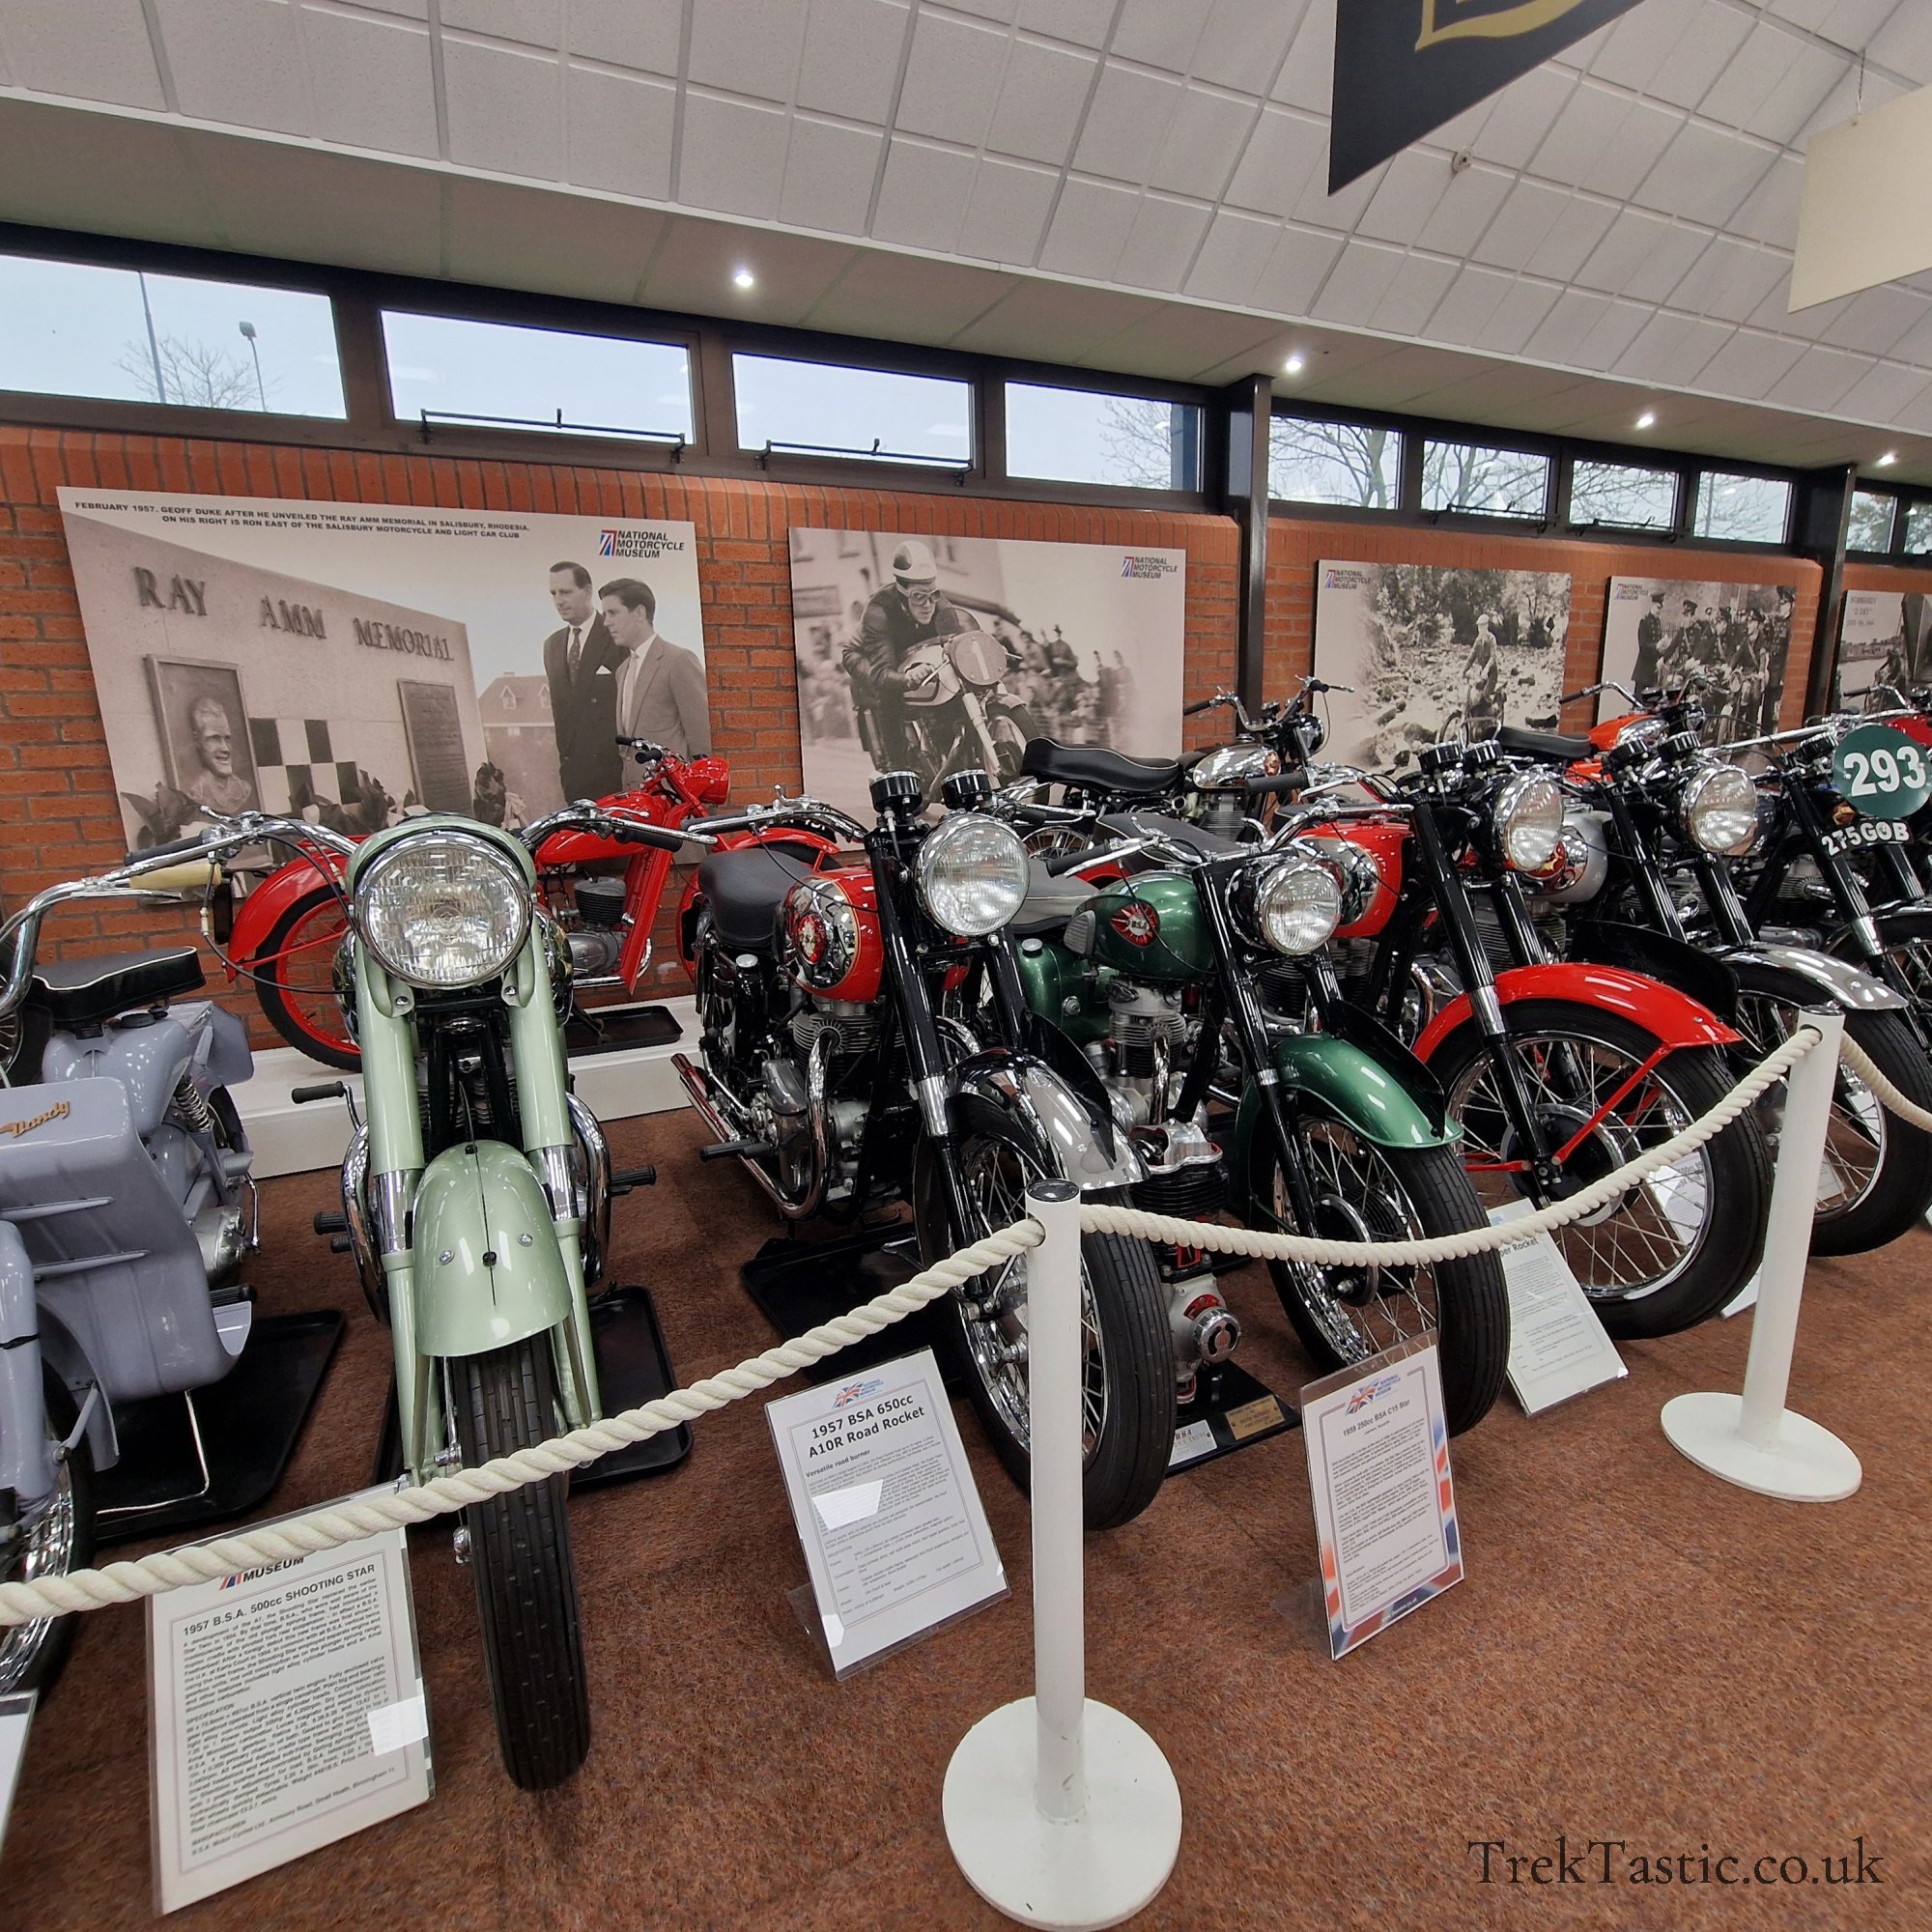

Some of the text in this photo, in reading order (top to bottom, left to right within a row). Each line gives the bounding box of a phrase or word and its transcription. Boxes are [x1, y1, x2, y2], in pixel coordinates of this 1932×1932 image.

[75, 501, 128, 511] FEBRUARY
[272, 512, 317, 521] UNVEILED
[440, 521, 486, 529] SALISBURY,
[488, 523, 530, 531] RHODESIA.
[199, 517, 227, 526] RIGHT
[326, 523, 373, 531] SALISBURY
[377, 526, 433, 534] MOTORCYCLE
[617, 540, 684, 551] MOTORCYCLE
[618, 530, 668, 540] NATIONAL
[616, 550, 660, 558] MUSEUM
[133, 566, 454, 661] RAY AMM MEMORIAL
[972, 640, 989, 680] 1
[1844, 746, 1926, 796] 293
[1512, 1236, 1538, 1251] Rocket
[811, 1395, 913, 1439] 1957 BSA 650cc
[1357, 1418, 1374, 1430] 250cc
[1375, 1411, 1386, 1421] BSA
[1387, 1405, 1398, 1414] C15
[1399, 1400, 1410, 1408] Star
[809, 1406, 924, 1458] A10R Road Rocket
[806, 1449, 870, 1477] Versatile road burner
[242, 1557, 304, 1582] MUSEUM
[184, 1564, 375, 1635] 1957 B.S.A. 500cc SHOOTING STAR
